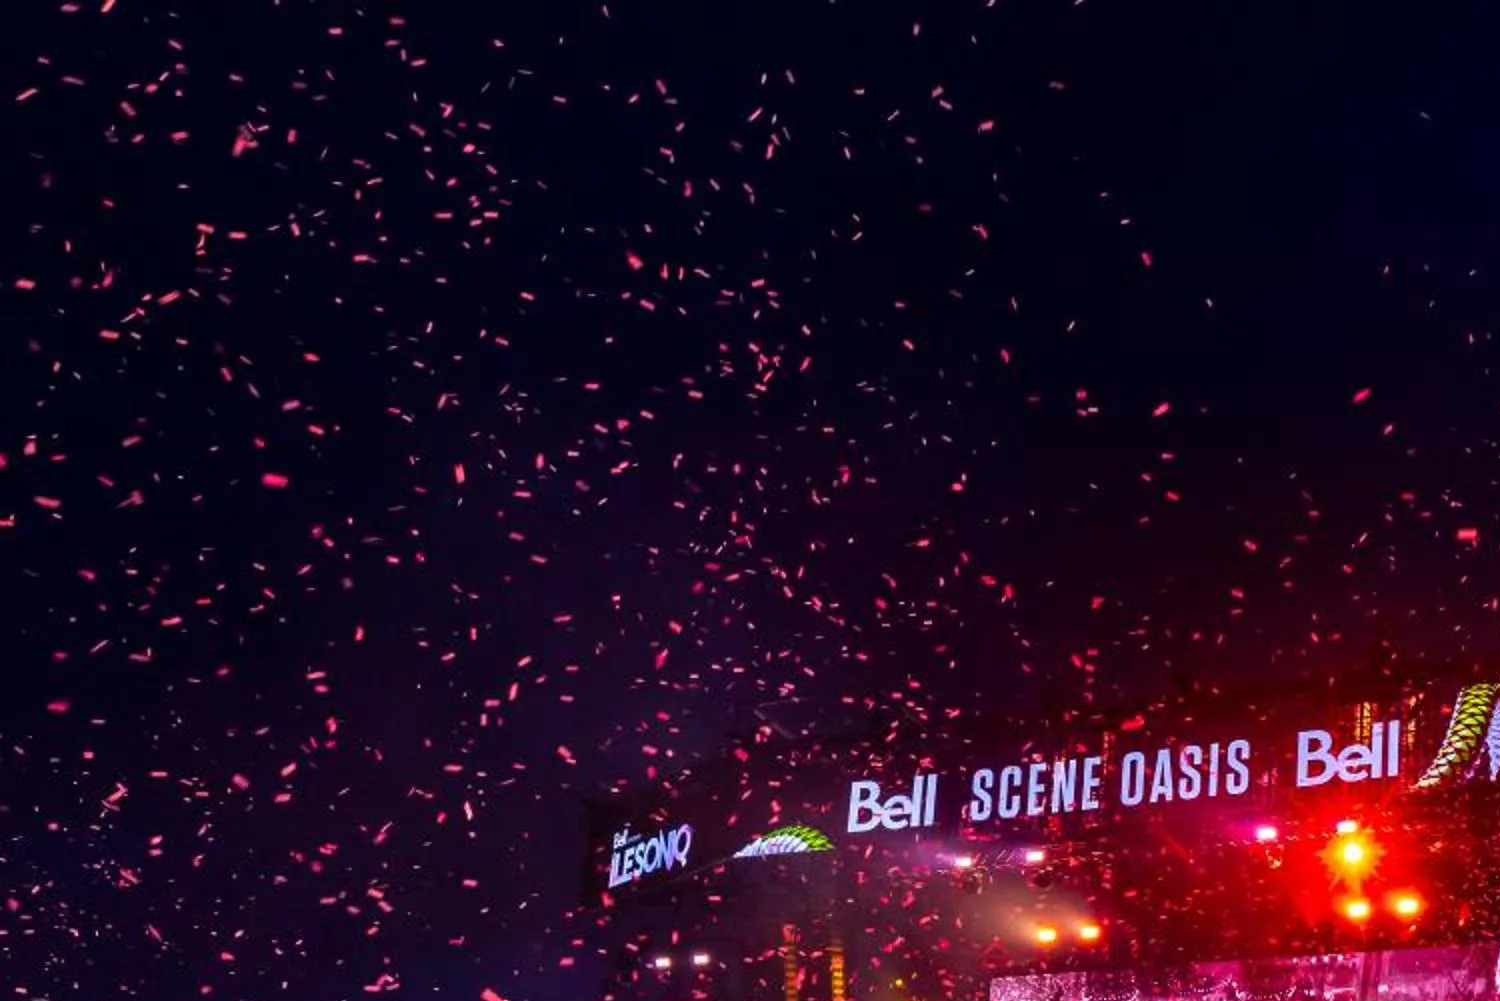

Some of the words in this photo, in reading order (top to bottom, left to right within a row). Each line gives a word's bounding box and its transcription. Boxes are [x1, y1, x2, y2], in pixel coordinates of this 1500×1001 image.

[848, 774, 938, 832] Bell
[1121, 739, 1250, 806] OASIS
[1297, 719, 1399, 787] Bell
